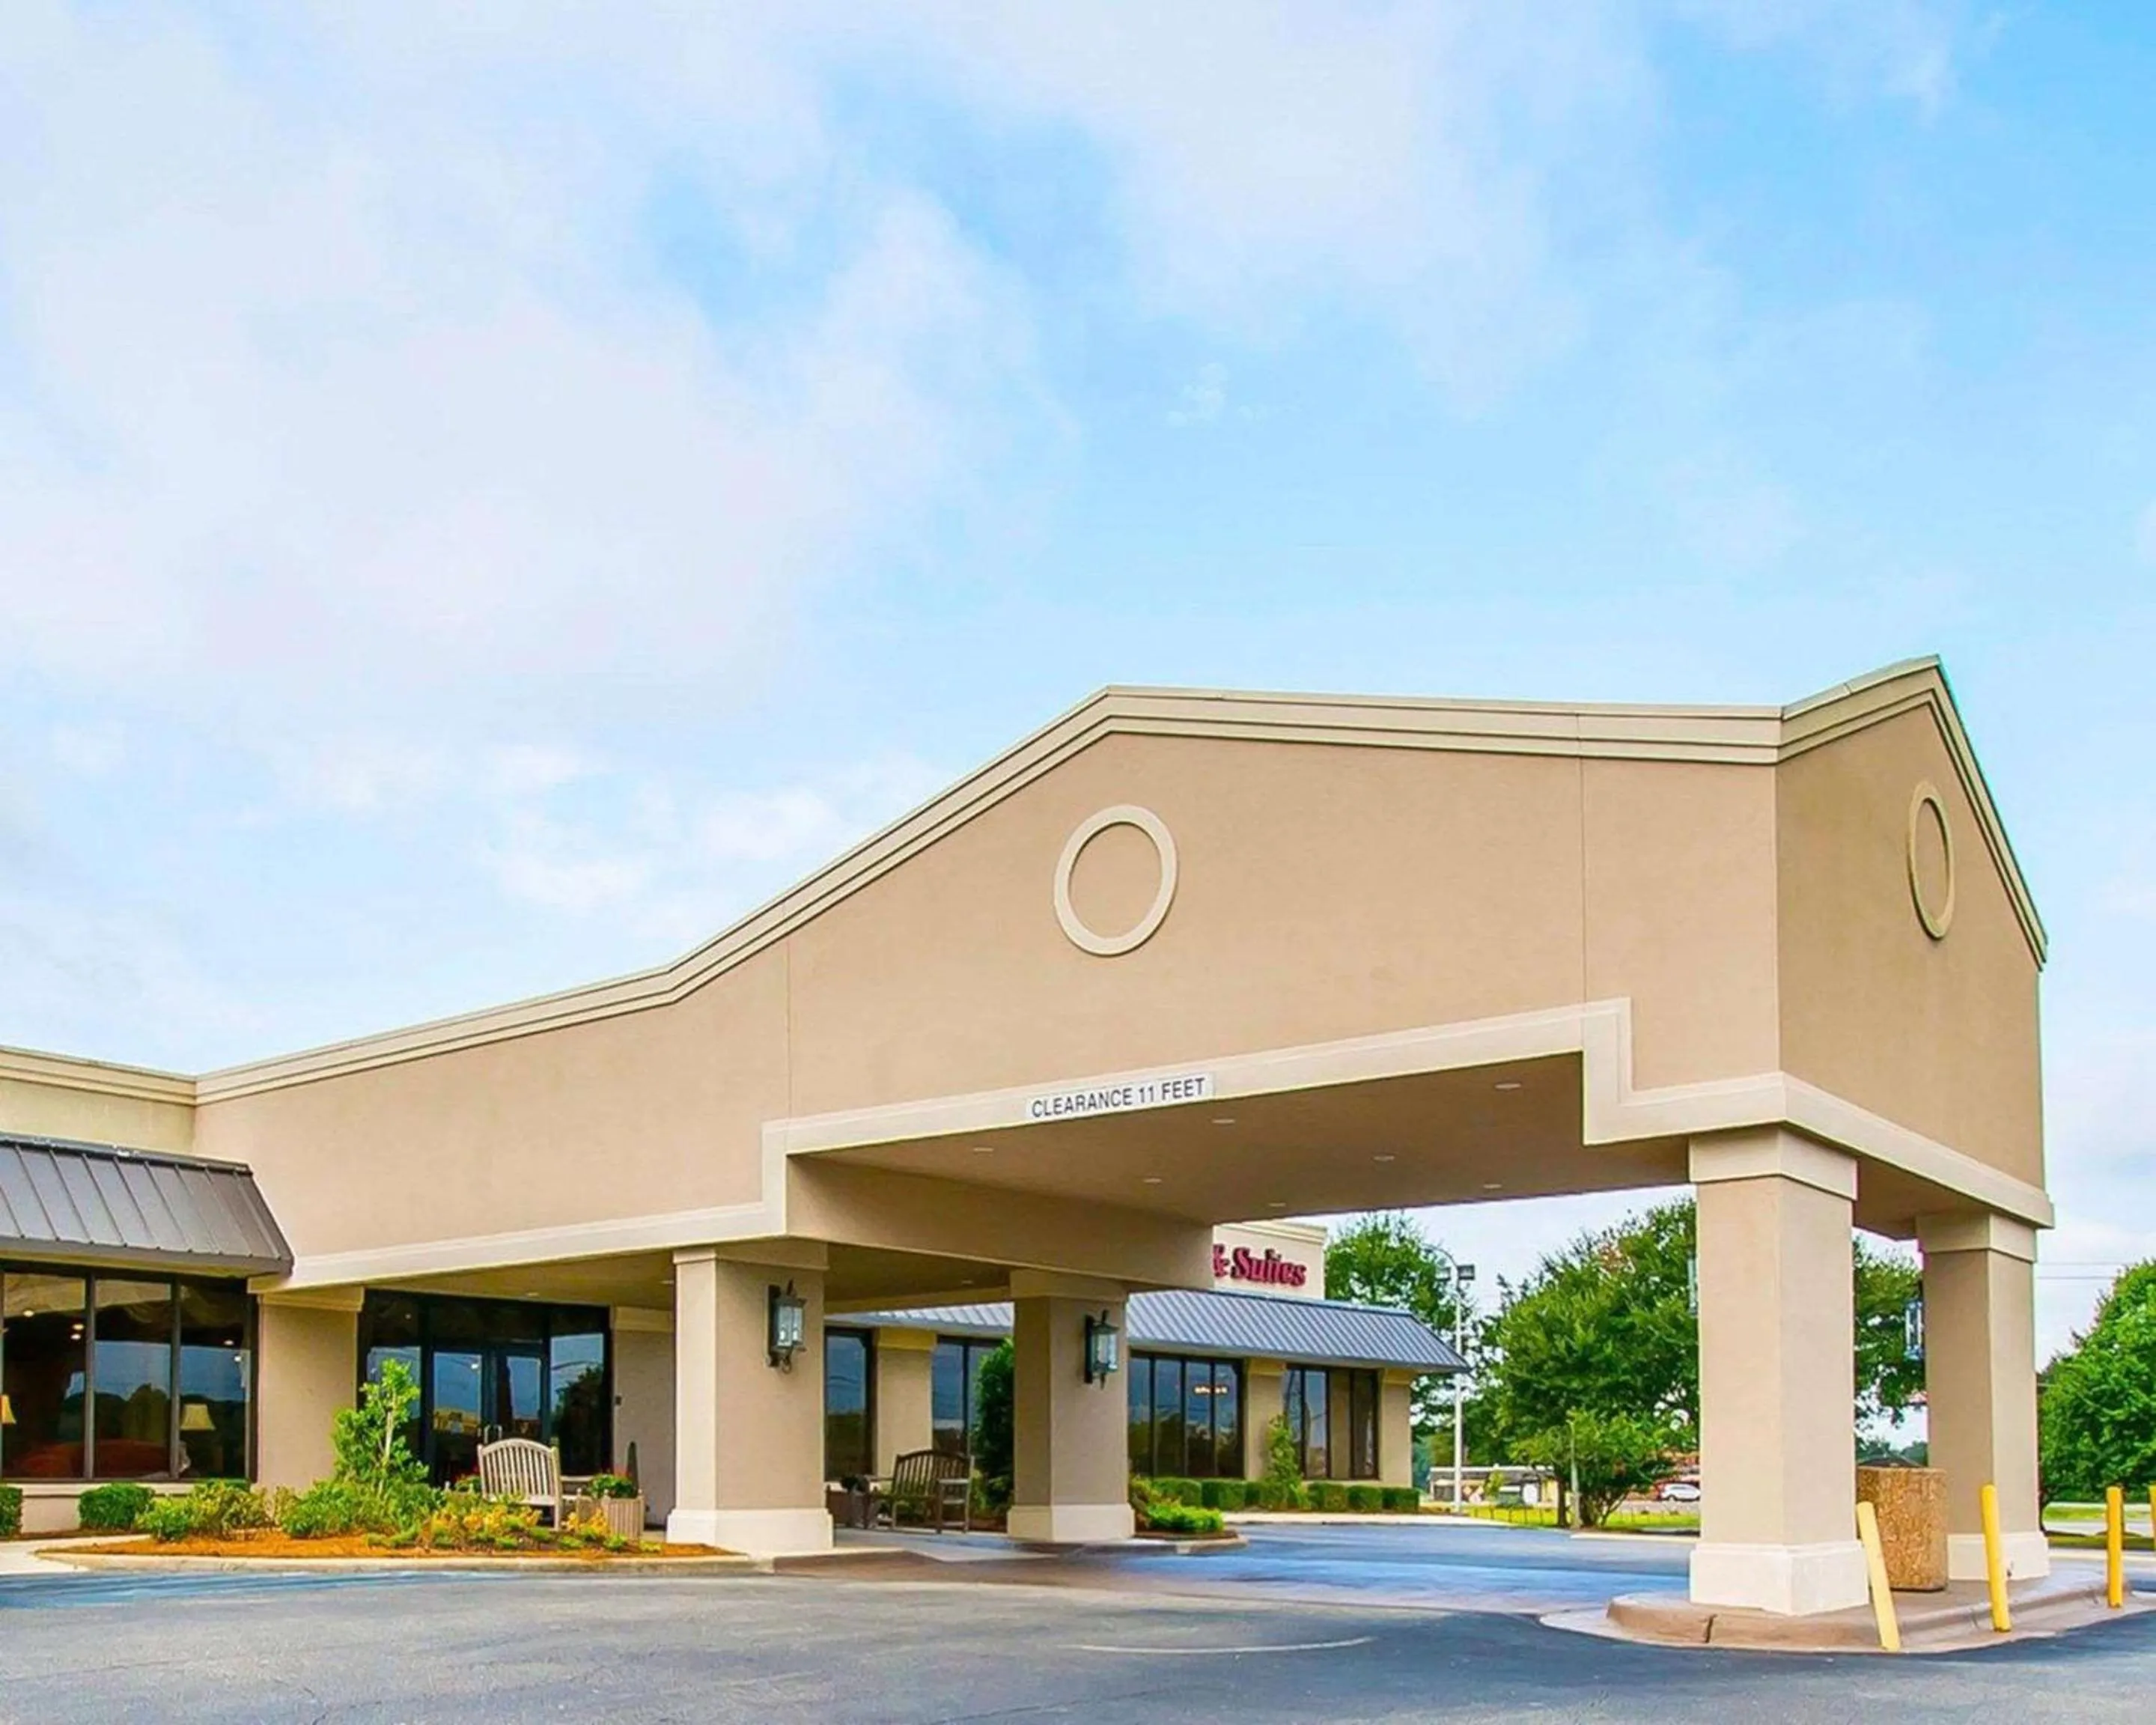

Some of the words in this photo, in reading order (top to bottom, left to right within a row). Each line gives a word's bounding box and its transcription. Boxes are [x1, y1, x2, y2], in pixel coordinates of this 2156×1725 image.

[1031, 1087, 1133, 1118] CLEARANCE
[1139, 1085, 1154, 1103] 11
[1161, 1077, 1205, 1101] FEET
[1230, 1247, 1307, 1287] Suites
